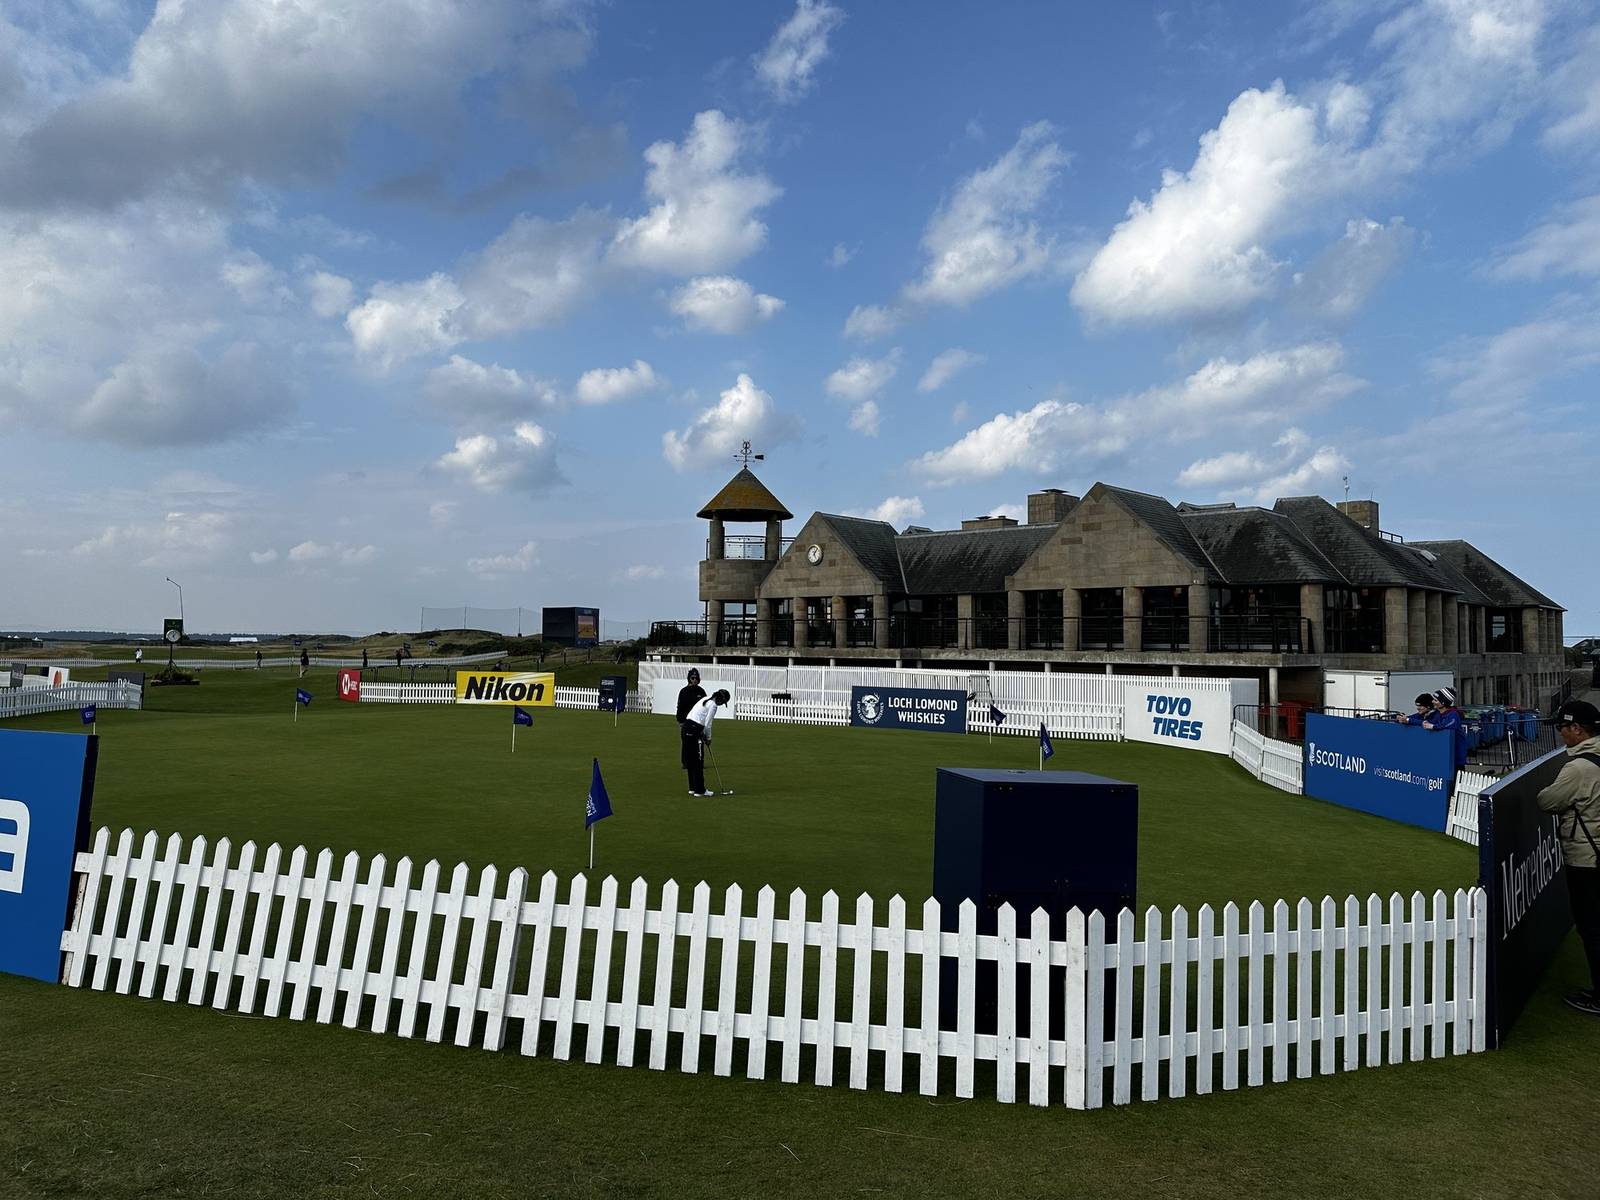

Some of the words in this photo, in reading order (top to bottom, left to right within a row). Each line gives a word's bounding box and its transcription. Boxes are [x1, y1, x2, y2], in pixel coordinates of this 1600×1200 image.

[464, 676, 545, 701] Nikon
[888, 697, 912, 709] LOCH
[916, 698, 958, 711] LOMOND
[1147, 695, 1191, 717] TOYO
[897, 711, 946, 724] WHISKIES
[1153, 717, 1203, 741] TIRES
[1316, 749, 1366, 774] SCOTLAND
[1374, 766, 1443, 791] visitscotland.com/golf
[1501, 814, 1565, 941] Mercedes-B
